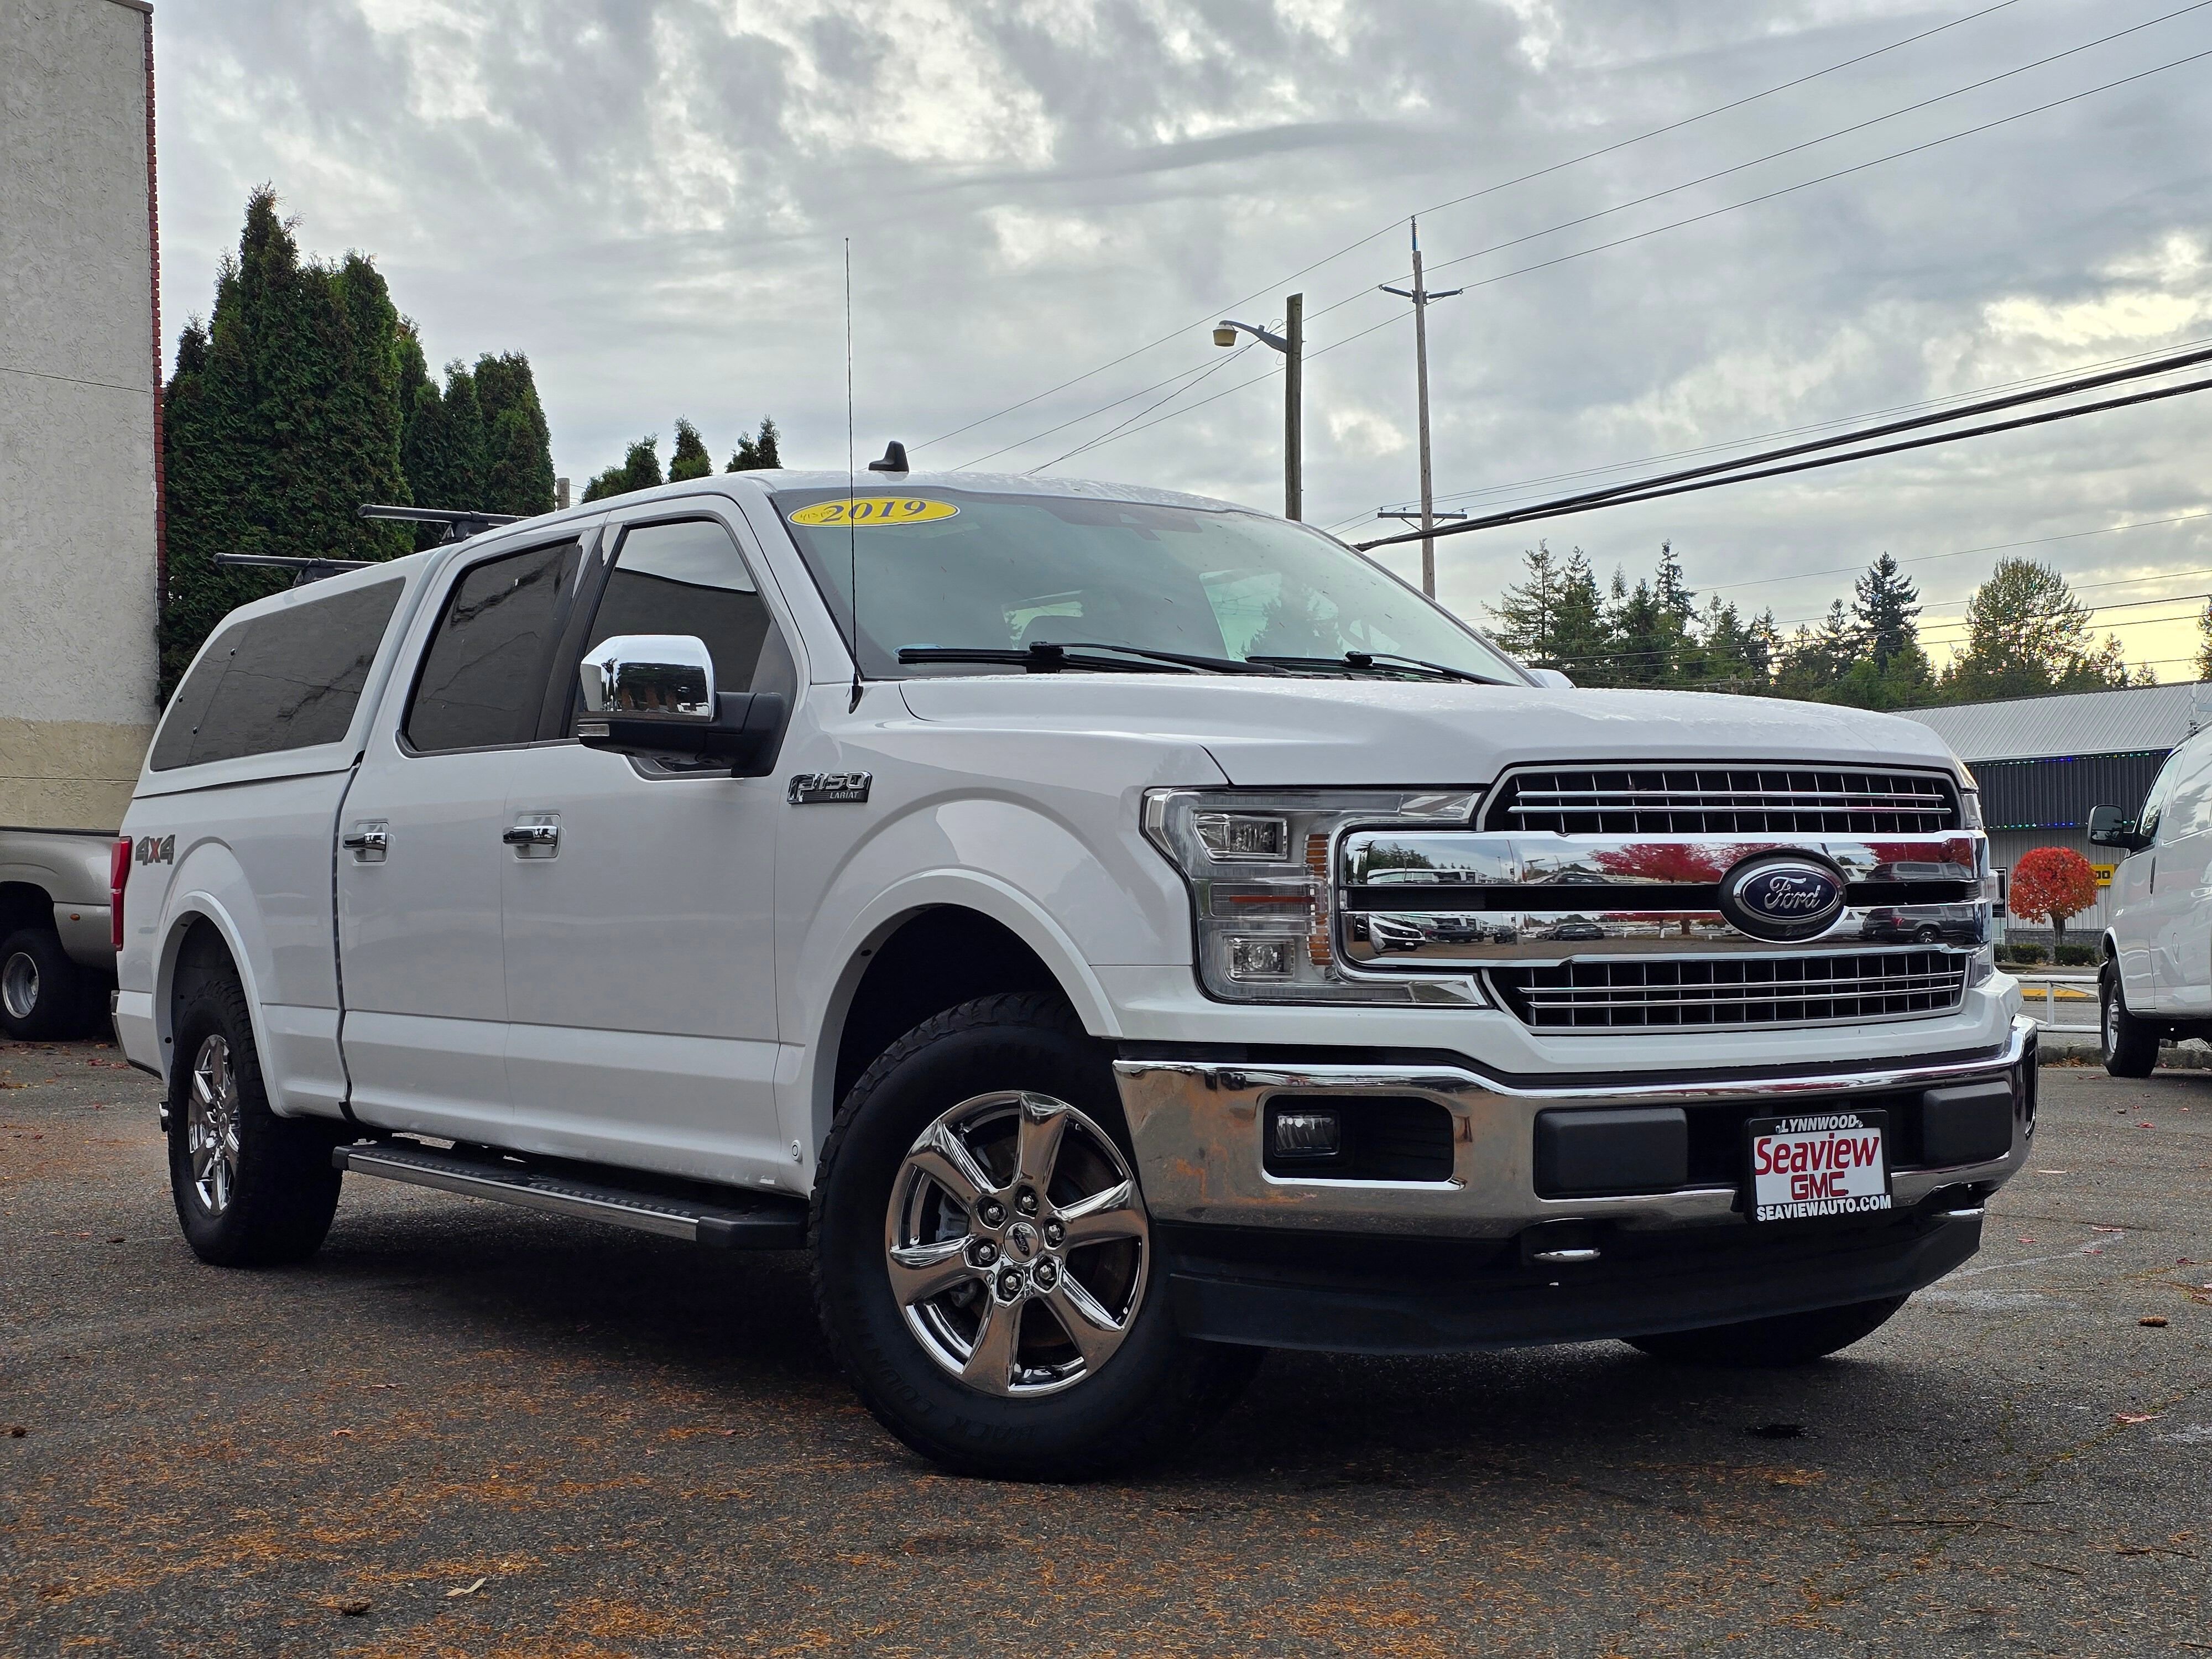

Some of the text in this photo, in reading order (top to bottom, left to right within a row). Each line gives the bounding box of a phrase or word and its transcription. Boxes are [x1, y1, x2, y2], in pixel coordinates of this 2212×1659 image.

[818, 500, 926, 523] 2019
[830, 791, 859, 800] LARIAT
[1764, 876, 1821, 910] Ford
[1781, 1114, 1857, 1133] LYNNWOOD
[1755, 1133, 1880, 1176] Seaview
[1791, 1171, 1845, 1201] GMC
[1756, 1194, 1892, 1222] SEAVIEWAUTO.COM
